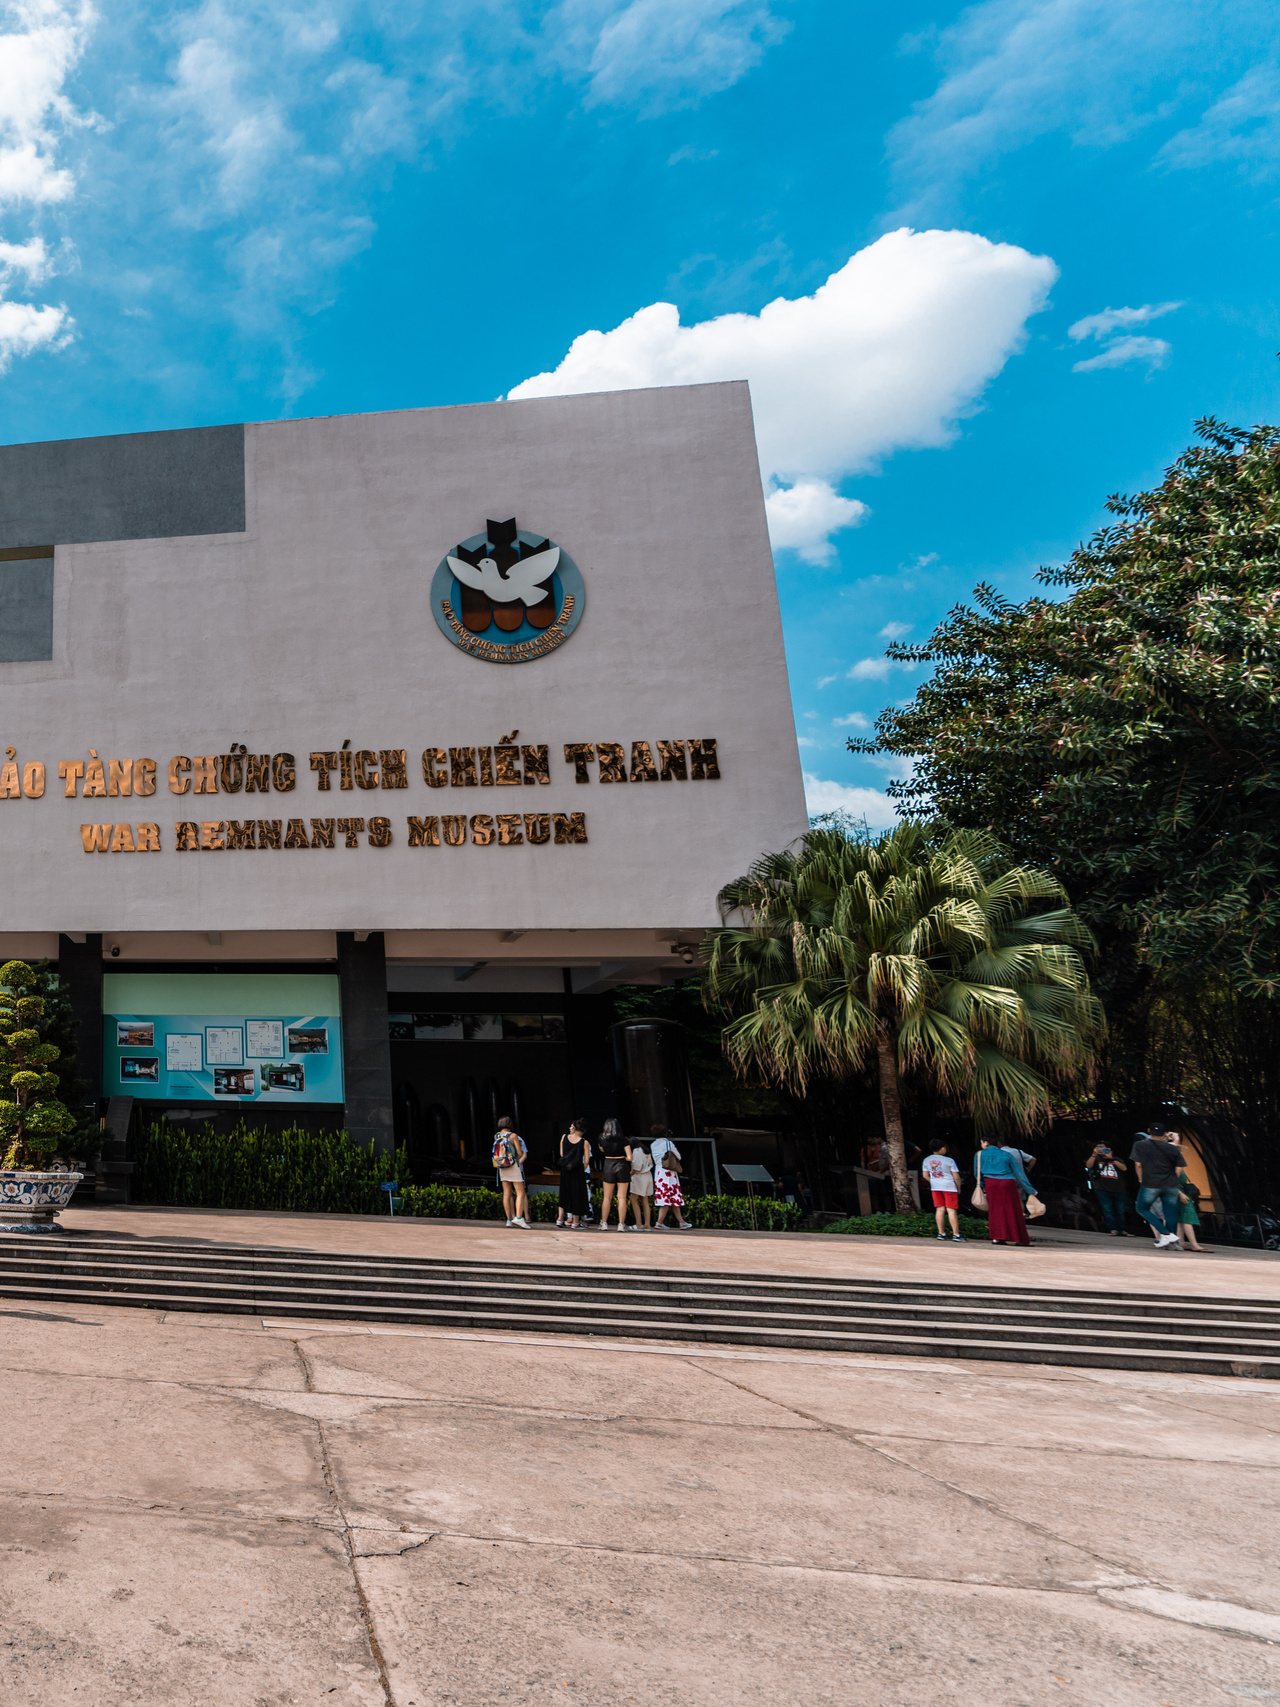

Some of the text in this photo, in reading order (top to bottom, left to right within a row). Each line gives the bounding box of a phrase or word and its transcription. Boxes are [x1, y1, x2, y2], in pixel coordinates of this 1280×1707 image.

[557, 595, 575, 626] TRANH
[458, 632, 567, 661] WAR REMNANTS MUSEUM
[58, 749, 157, 798] TÀNG
[168, 743, 296, 796] CHỨNG
[309, 739, 409, 791] TÍCH
[422, 729, 551, 788] CHIẾN
[563, 738, 721, 784] TRANH
[80, 812, 588, 853] WAR REMNANTS MUSEUM
